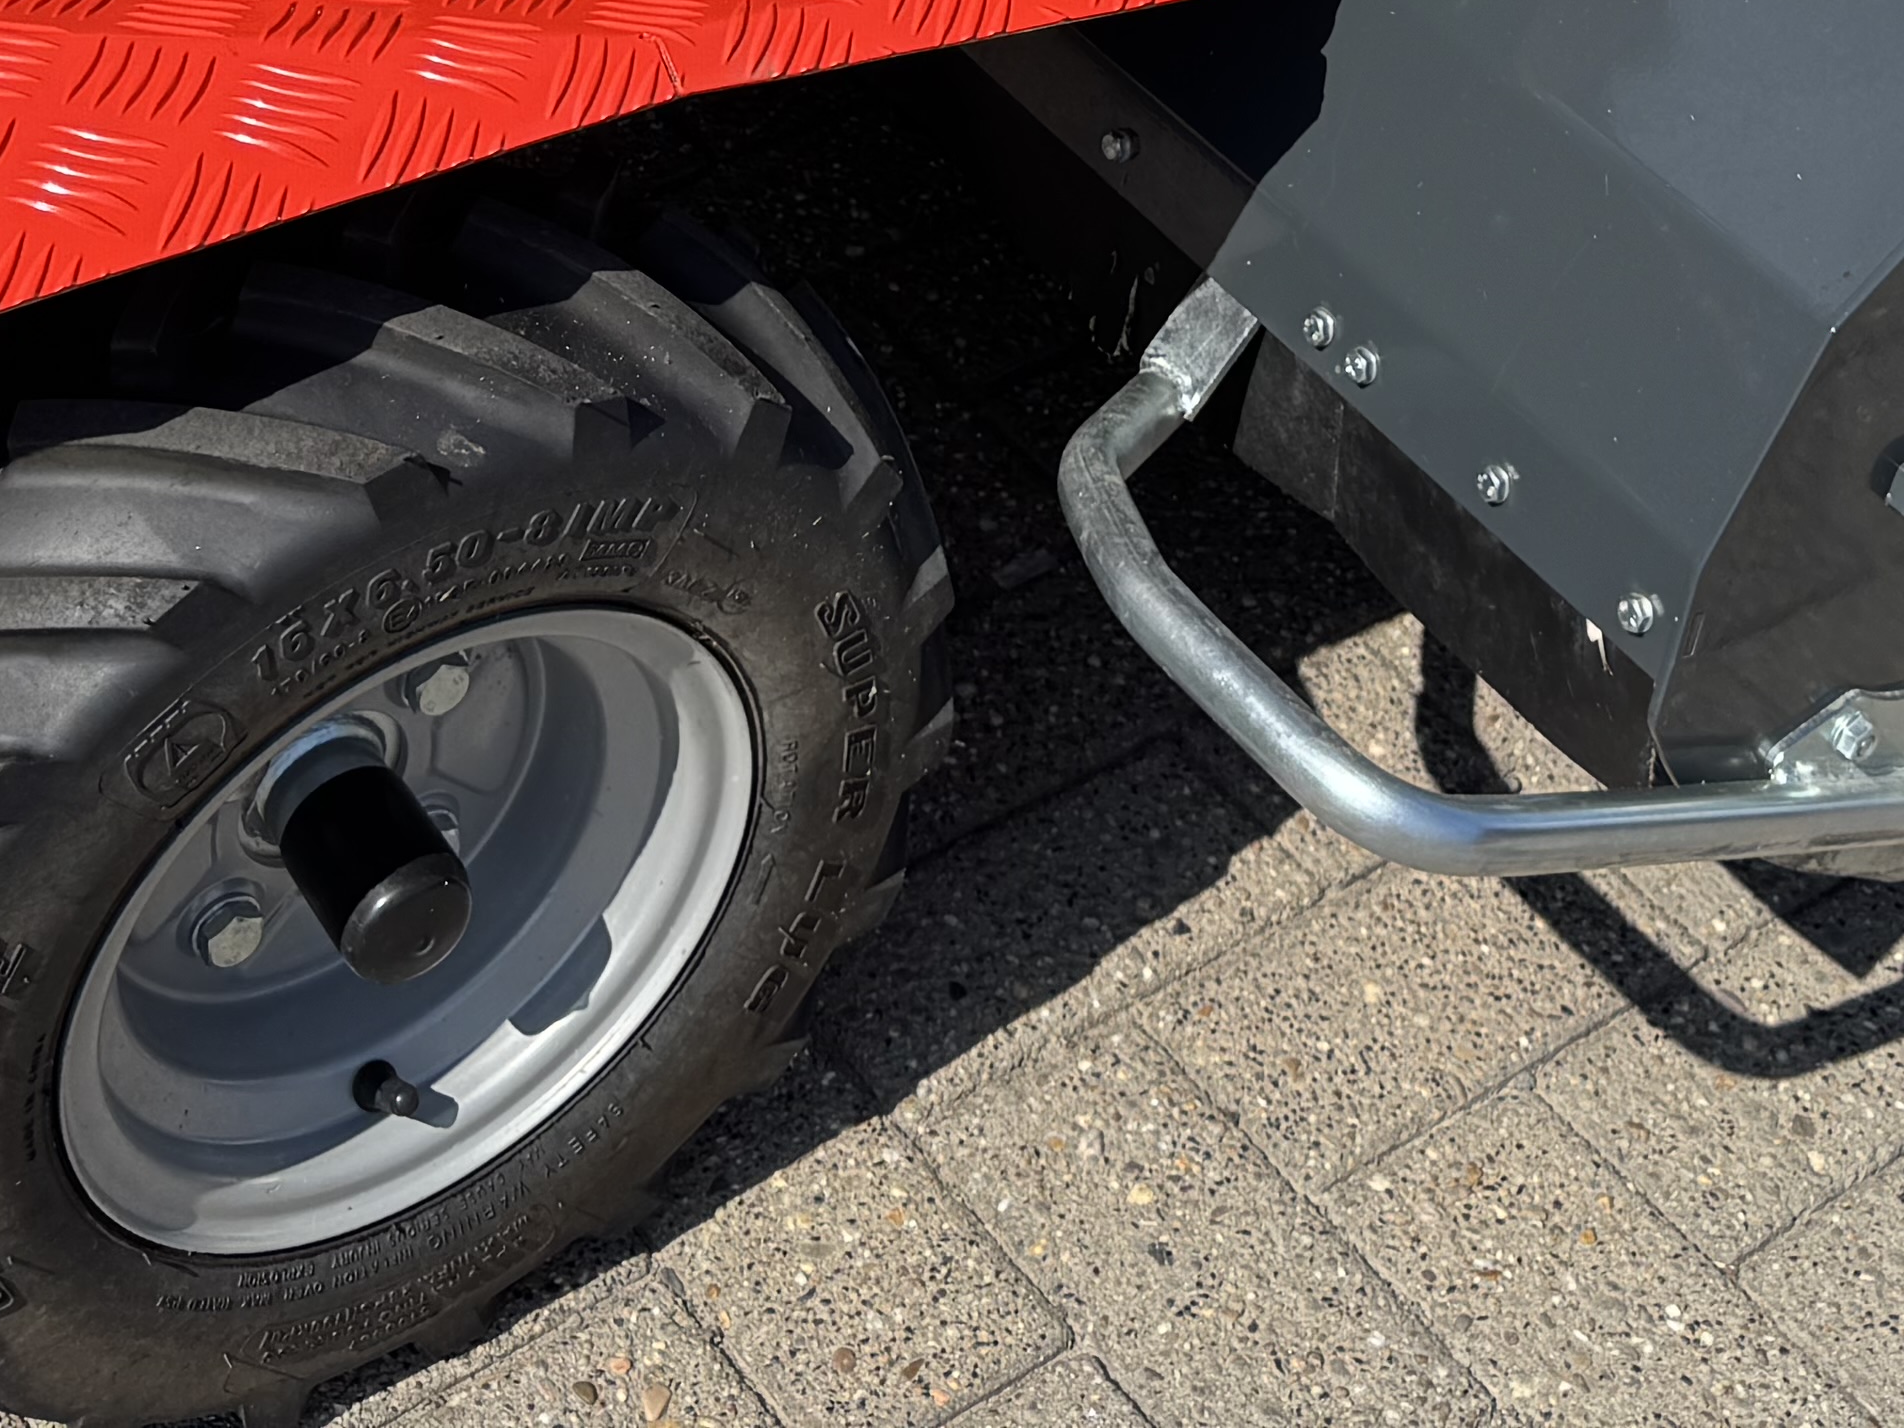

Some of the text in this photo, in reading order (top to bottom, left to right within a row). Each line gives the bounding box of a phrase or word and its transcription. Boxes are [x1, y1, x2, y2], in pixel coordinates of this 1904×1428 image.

[743, 590, 878, 1013] SUPER LUG
[544, 1102, 625, 1179] SAFETY
[430, 1181, 530, 1249] WARNING
[237, 1261, 315, 1288] EXPLOSION
[330, 1236, 381, 1271] INJURY
[332, 1247, 416, 1289] INFLATION
[282, 1280, 325, 1302] OVER
